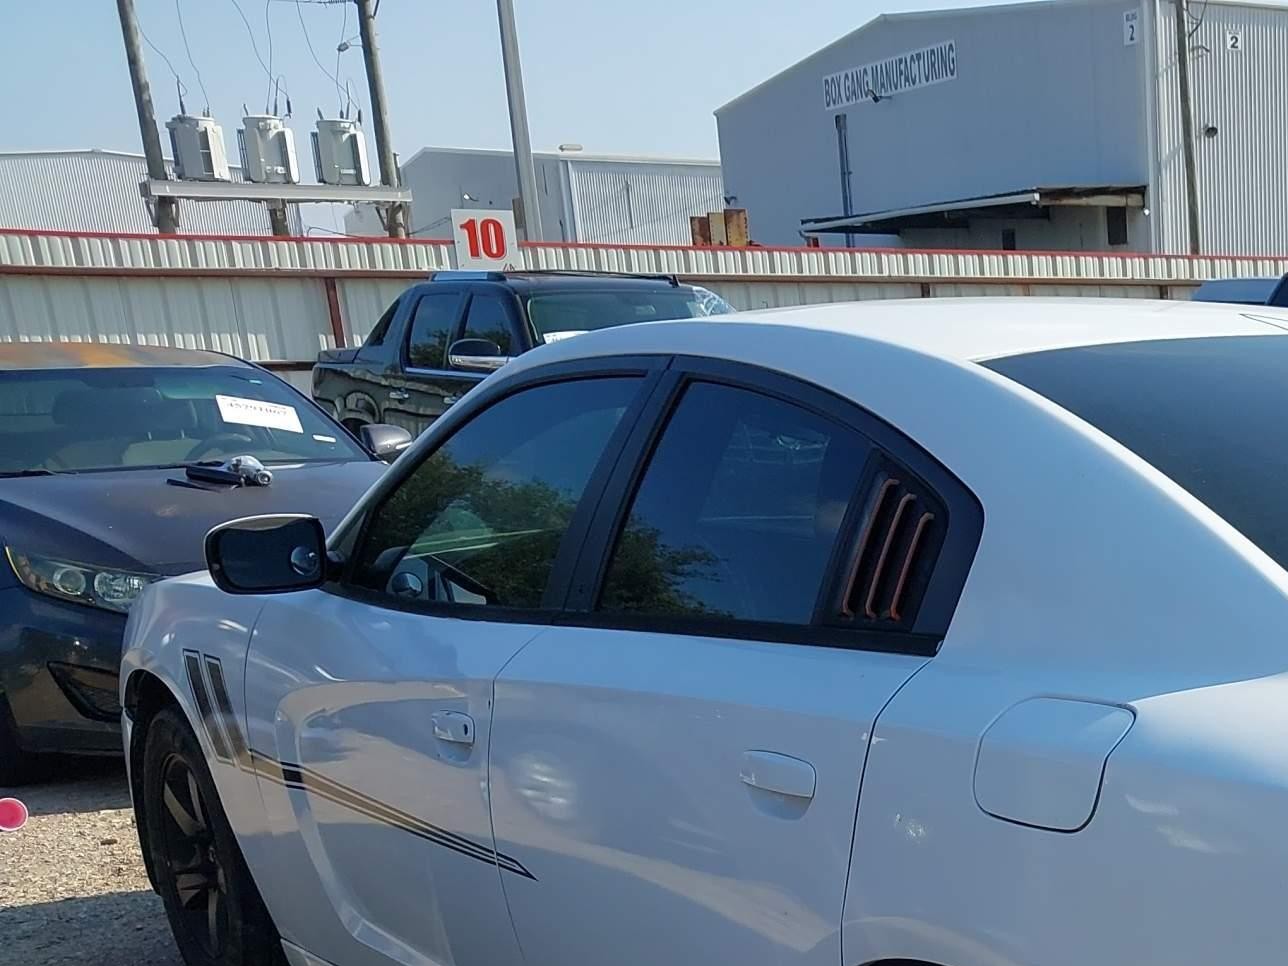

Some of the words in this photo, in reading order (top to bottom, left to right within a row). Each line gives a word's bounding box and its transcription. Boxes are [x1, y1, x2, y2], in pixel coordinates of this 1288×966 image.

[1230, 36, 1239, 49] 2
[824, 75, 842, 107] BOX
[844, 67, 869, 101] GANG
[871, 43, 956, 95] MANUFACTURING
[459, 218, 507, 258] 10
